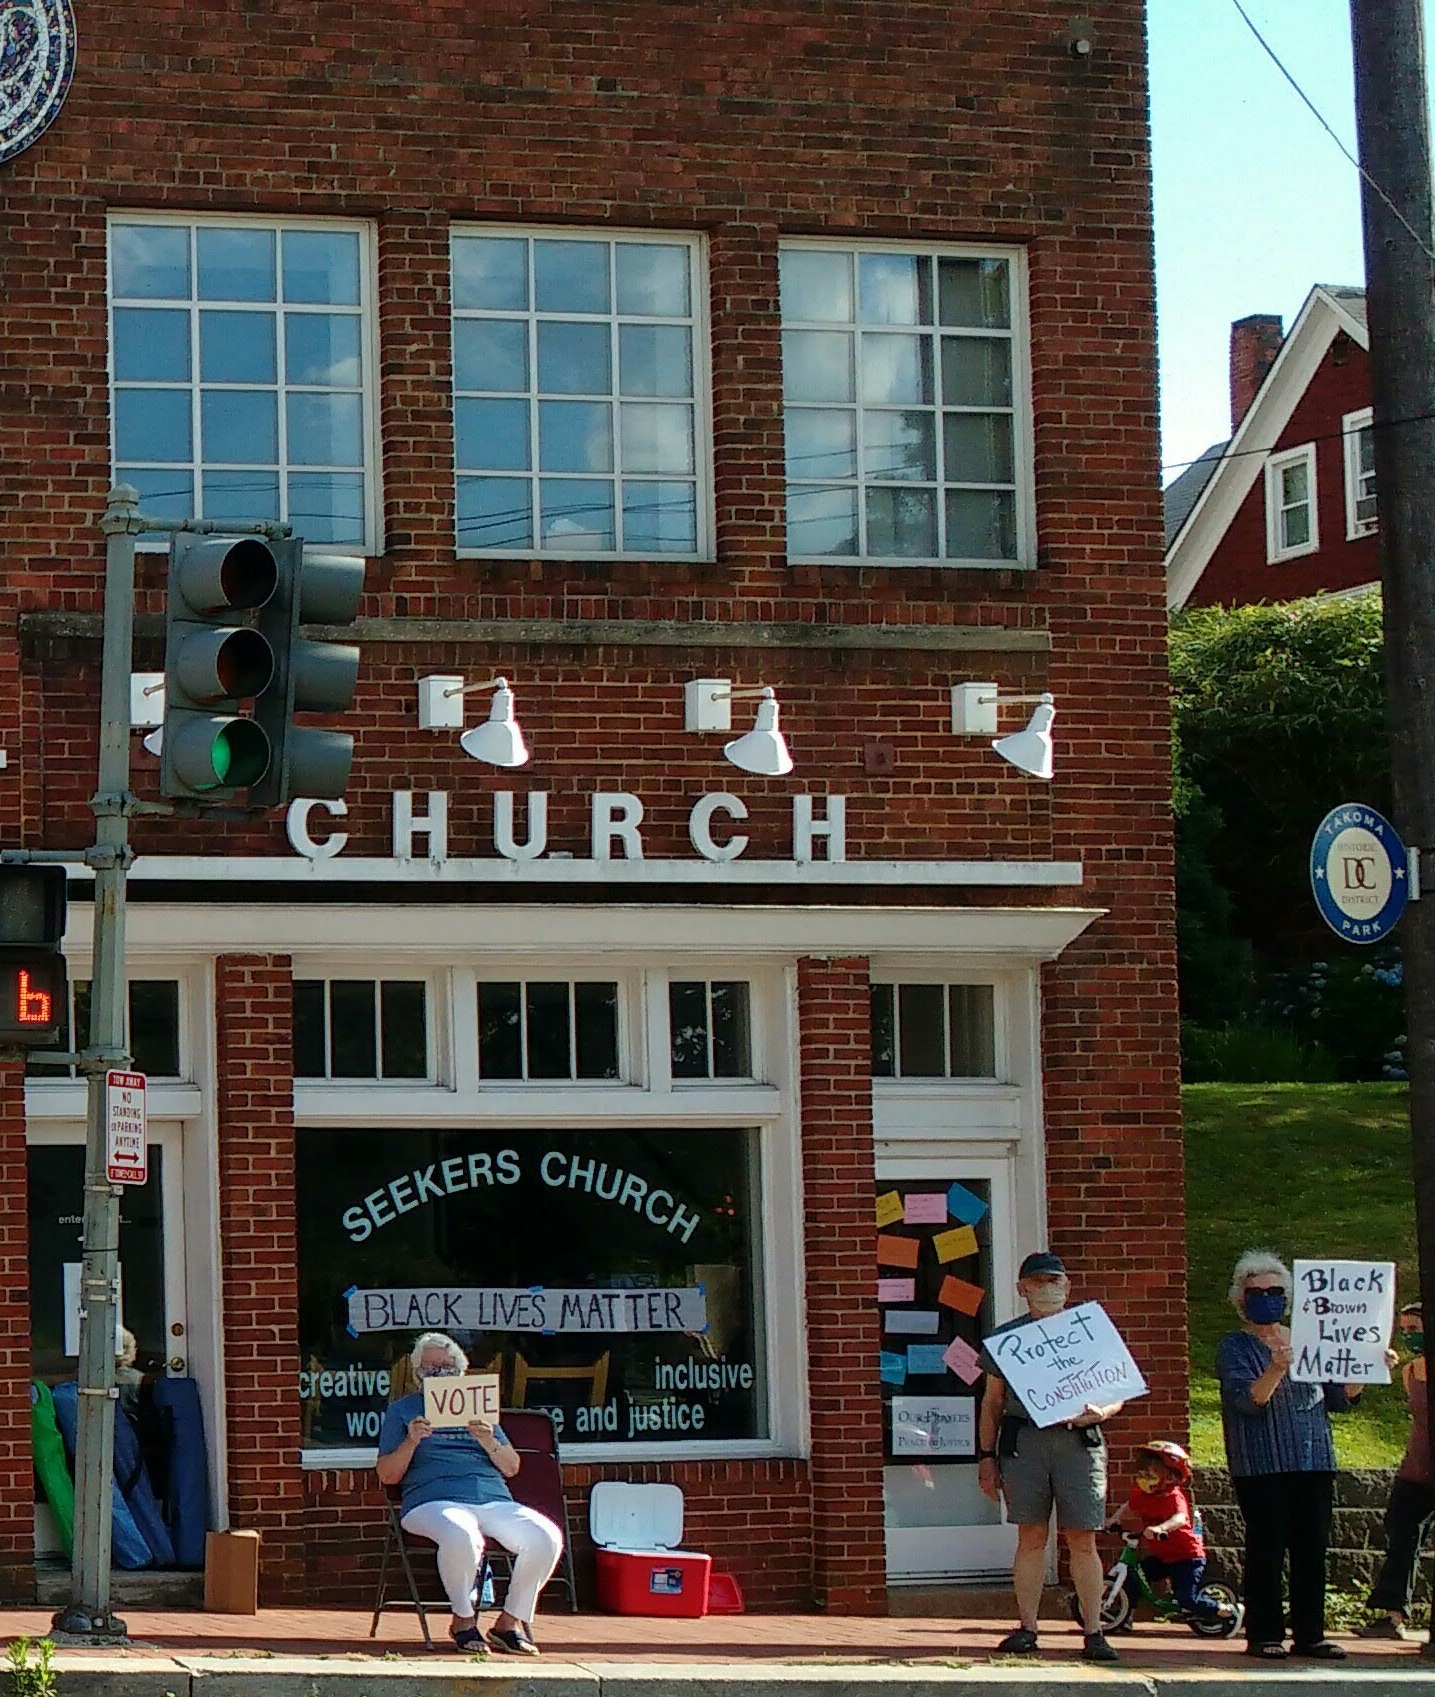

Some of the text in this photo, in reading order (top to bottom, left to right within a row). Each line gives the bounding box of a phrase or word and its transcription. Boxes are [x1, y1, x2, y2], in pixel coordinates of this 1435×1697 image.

[287, 790, 847, 862] CHURCH
[1324, 810, 1384, 837] TAKOMA
[1342, 857, 1377, 890] DC
[1342, 920, 1382, 936] PARK
[112, 1074, 125, 1086] TOW
[122, 1092, 132, 1103] NO
[112, 1106, 141, 1119] STANDING
[116, 1122, 142, 1134] PARKING
[115, 1135, 140, 1149] ANYTIME
[341, 1148, 701, 1244] SEEKERS CHURCH
[1301, 1268, 1384, 1294] Black
[364, 1291, 686, 1331] BLACK LIVES MATTER
[1311, 1296, 1368, 1316] Brown
[997, 1311, 1095, 1365] Protect
[1319, 1318, 1381, 1344] Lives
[1046, 1355, 1084, 1371] the
[1296, 1345, 1375, 1377] Matter
[298, 1355, 753, 1399] creative inclusive
[430, 1384, 498, 1416] VOTE
[576, 1396, 618, 1433] and
[628, 1396, 705, 1438] justice
